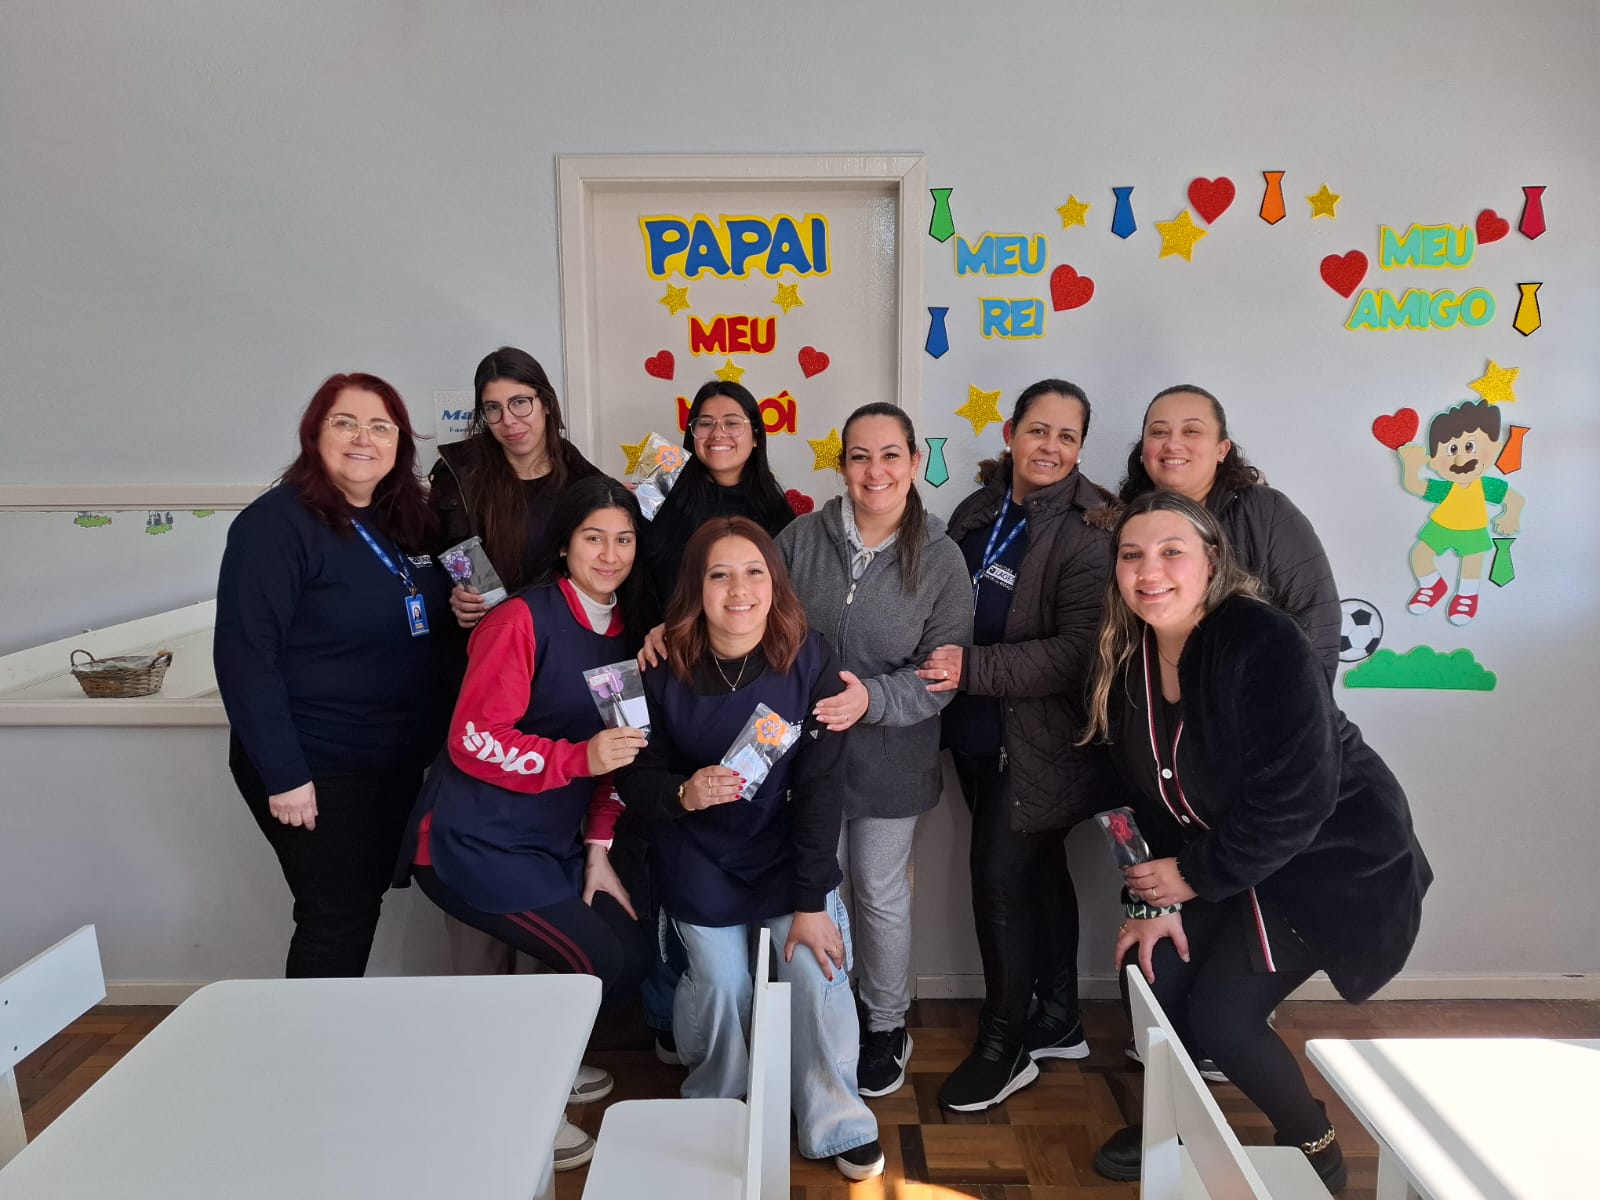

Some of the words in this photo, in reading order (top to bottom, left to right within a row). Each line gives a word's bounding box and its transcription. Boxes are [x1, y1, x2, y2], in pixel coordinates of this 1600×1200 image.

[643, 216, 829, 277] PAPAI
[955, 234, 1047, 275] MEU
[1382, 225, 1475, 268] MEU
[980, 298, 1046, 337] REI
[1347, 288, 1496, 329] AMIGO
[689, 316, 777, 354] MEU
